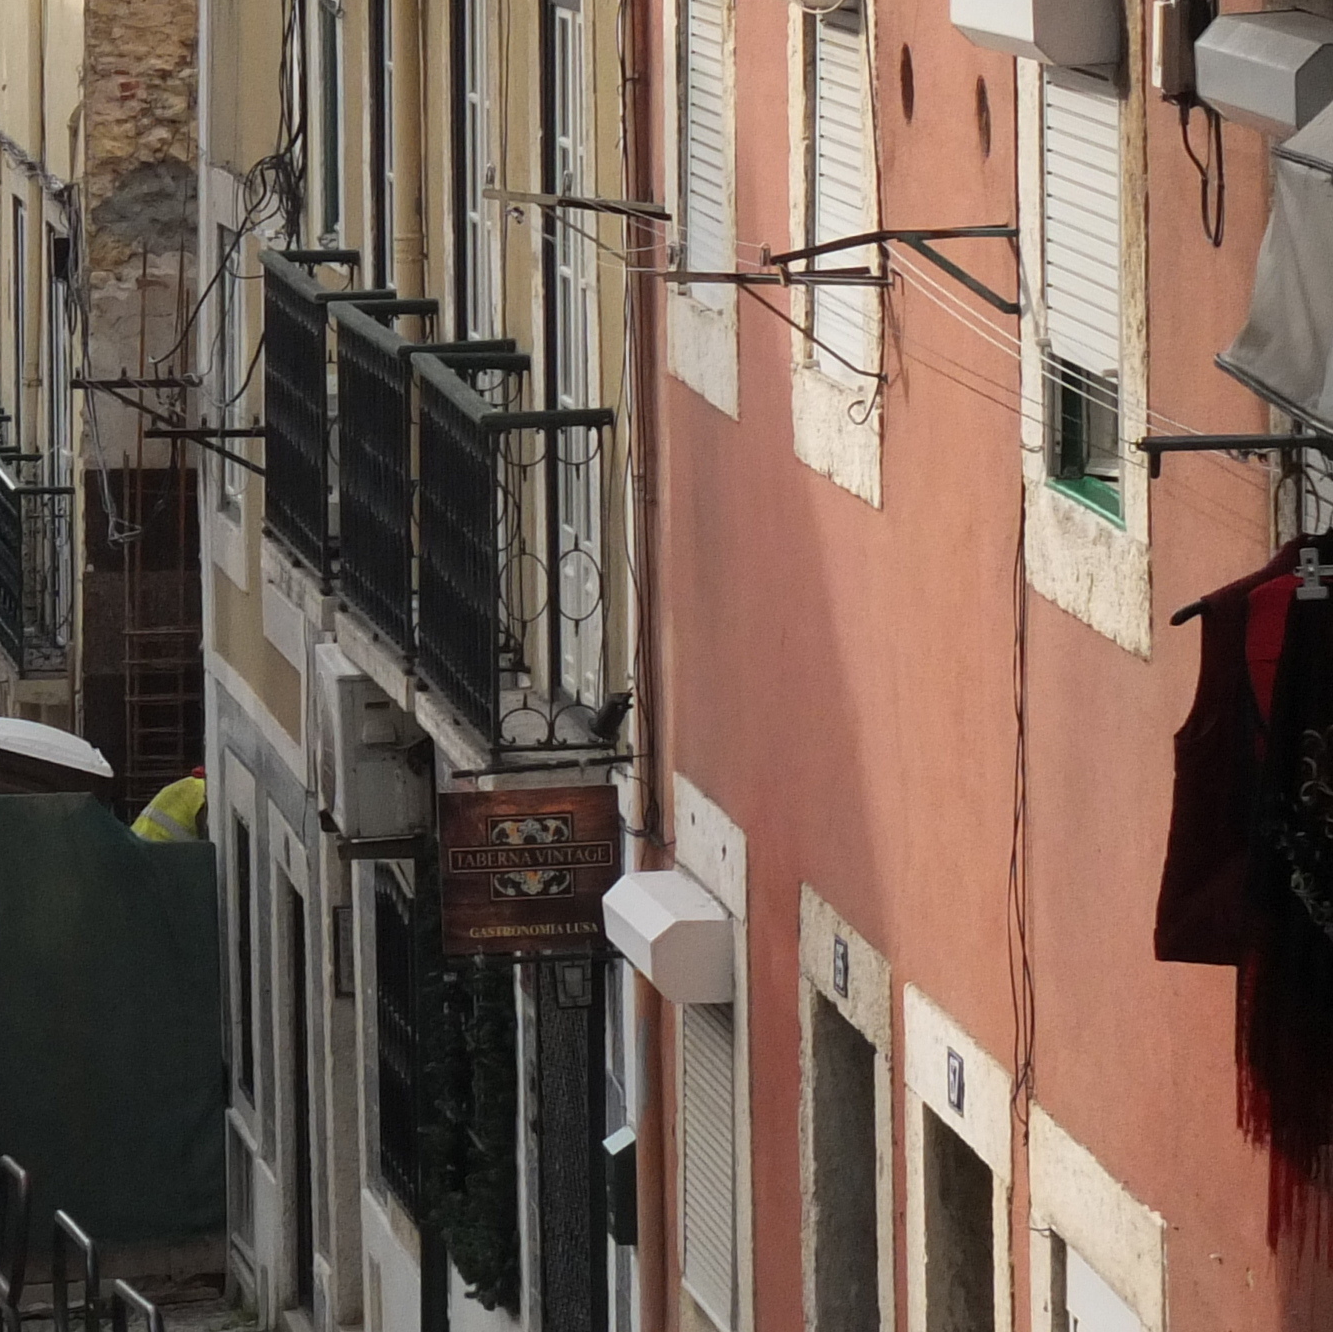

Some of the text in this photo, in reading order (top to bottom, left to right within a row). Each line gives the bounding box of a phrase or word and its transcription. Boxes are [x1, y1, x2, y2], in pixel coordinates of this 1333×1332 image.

[455, 846, 608, 868] TABERNA VINTAGE
[470, 921, 599, 939] GASTRONOMIA LUSA
